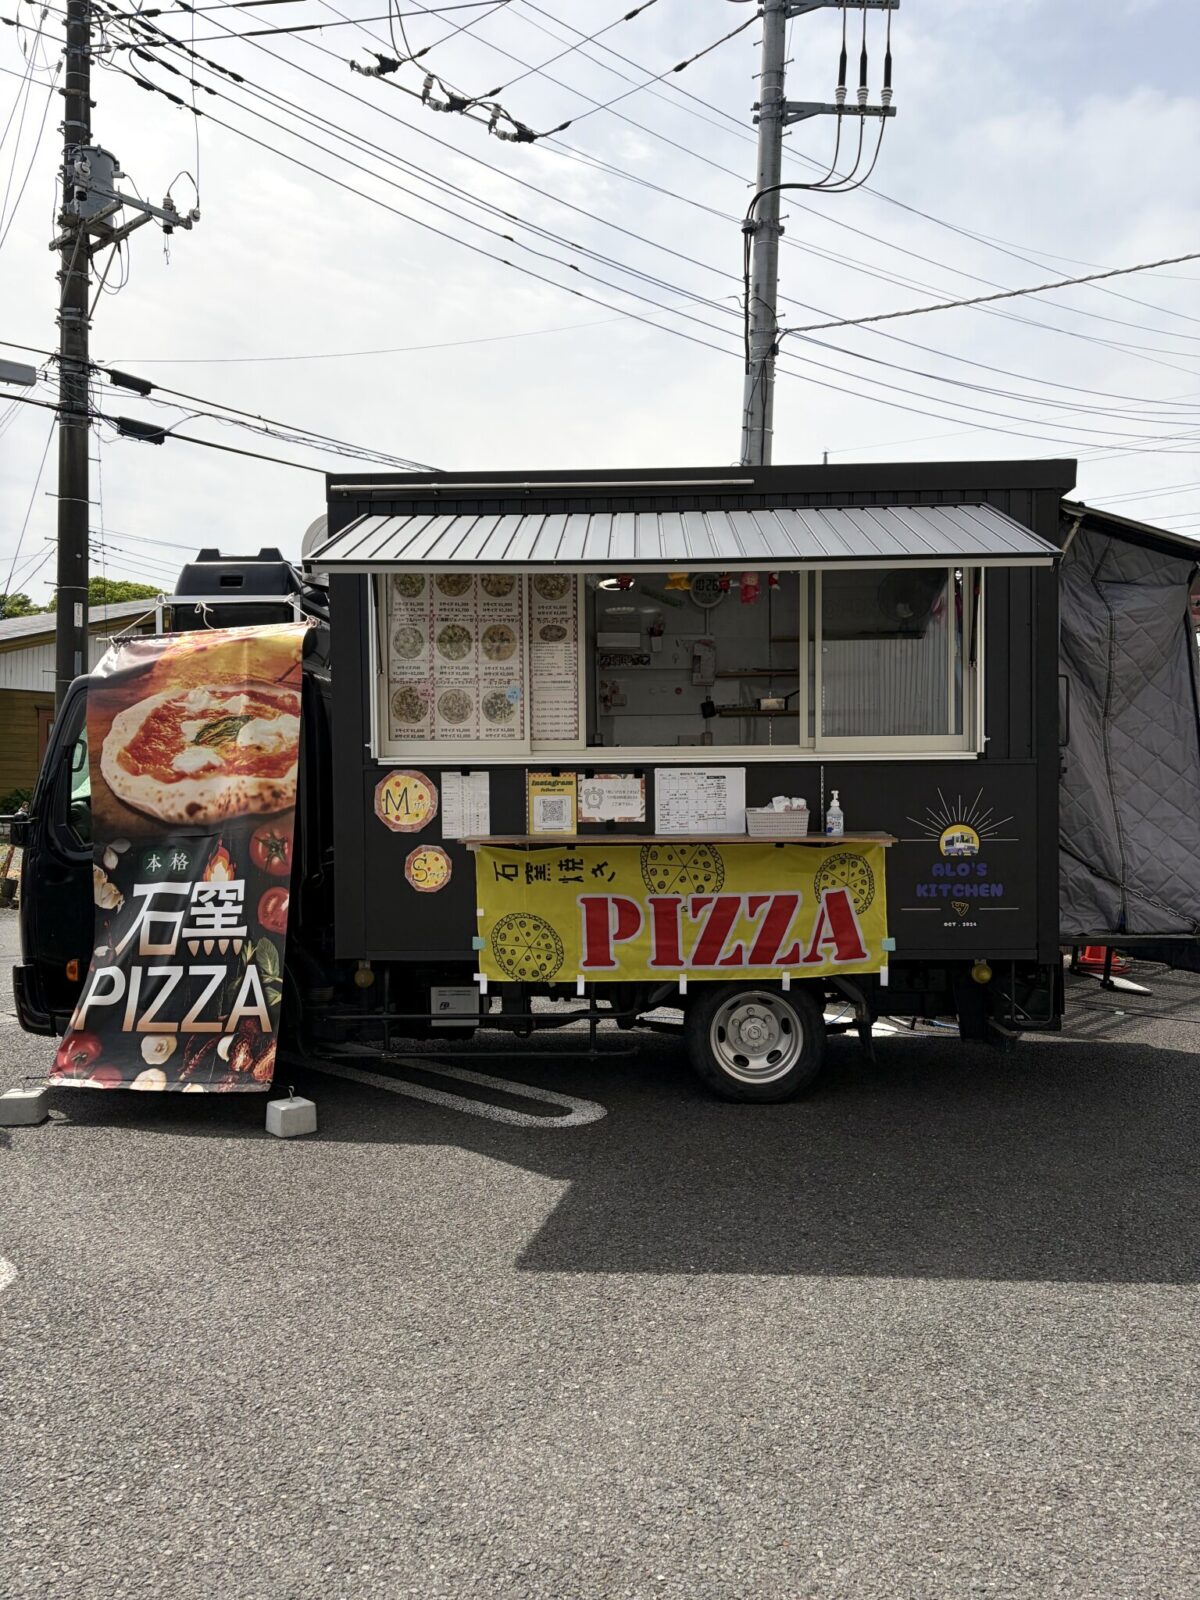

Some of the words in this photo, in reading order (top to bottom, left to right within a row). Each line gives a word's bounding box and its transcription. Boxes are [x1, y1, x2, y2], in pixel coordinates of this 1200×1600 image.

[145, 852, 190, 873] 本格
[931, 862, 988, 877] ALO'S
[916, 882, 1004, 897] KITCHEN
[114, 878, 248, 957] 石窯
[578, 889, 870, 970] PIZZA
[73, 964, 272, 1033] PIZZA
